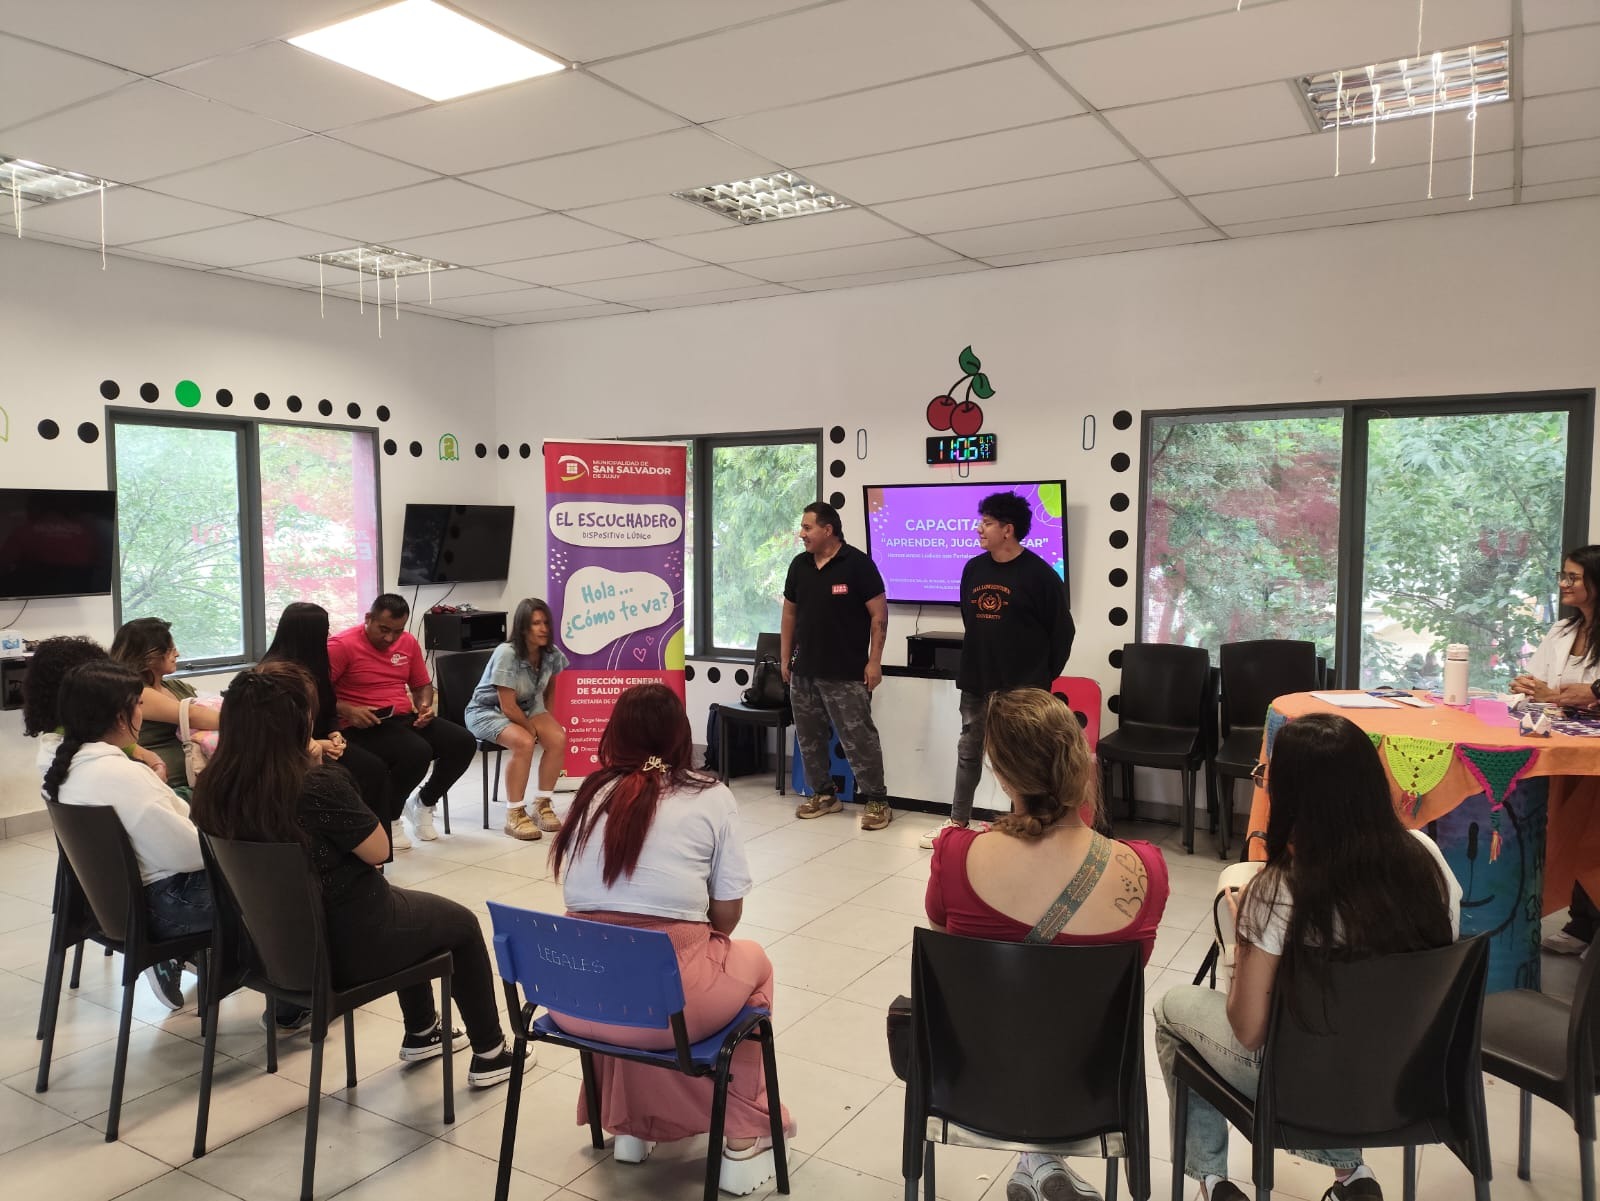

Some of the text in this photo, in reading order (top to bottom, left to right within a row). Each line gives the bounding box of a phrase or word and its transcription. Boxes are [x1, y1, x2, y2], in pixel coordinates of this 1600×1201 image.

[592, 465, 671, 476] SAN SALVADOR
[556, 511, 677, 529] EL ESCUCHADERO
[905, 518, 981, 532] CAPACITA
[582, 531, 652, 540] DISPOSITIVO LÚDICO
[951, 537, 980, 548] JUGA
[1019, 537, 1049, 548] EAR"
[565, 591, 669, 639] ¿Cómo te va?
[577, 676, 665, 685] DIRECCIÓN GENERAL
[577, 687, 589, 695] DE
[591, 687, 621, 695] SALUD
[537, 943, 605, 974] LEGALES
